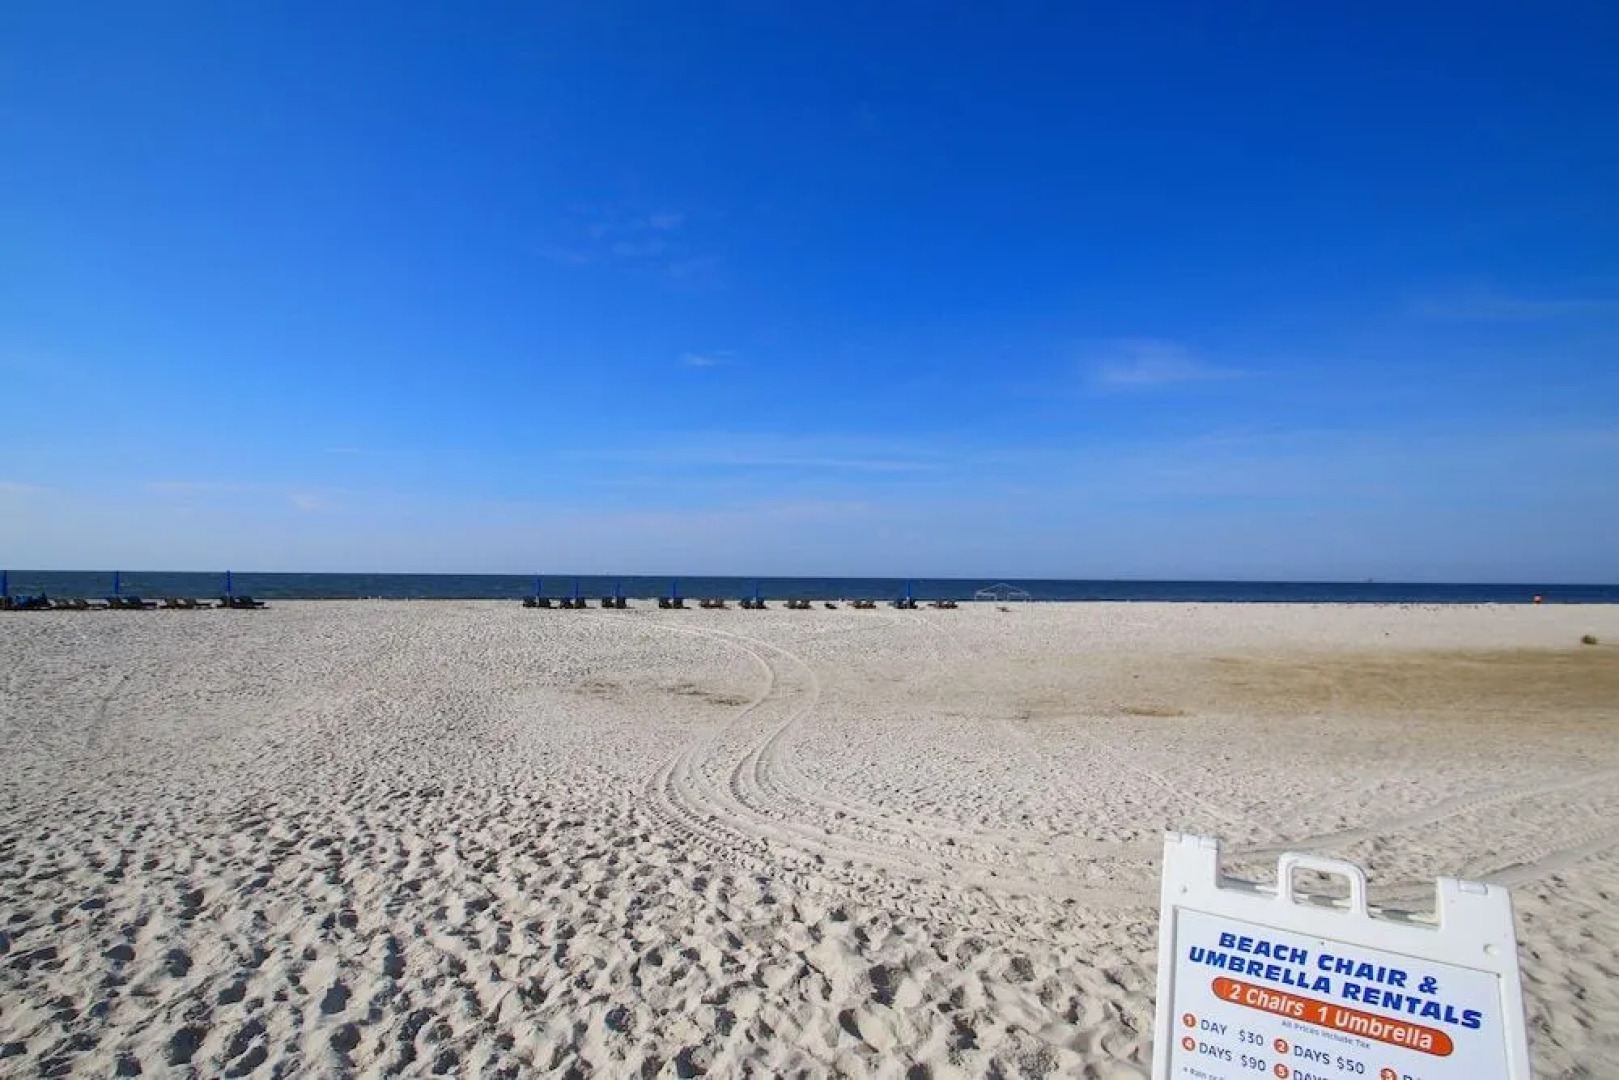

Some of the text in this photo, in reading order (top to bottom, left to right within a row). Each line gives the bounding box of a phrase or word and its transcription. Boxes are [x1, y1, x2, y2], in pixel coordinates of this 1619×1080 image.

[1219, 932, 1438, 994] BEACH CHAIR &
[1189, 947, 1482, 1029] UMBRELLA RENTALS
[1230, 984, 1432, 1049] 2 Chairs 1 Umbrella
[1201, 1019, 1227, 1035] DAY
[1239, 1030, 1264, 1046] $30
[1200, 1042, 1232, 1061] DAYS
[1241, 1055, 1266, 1071] $90
[1294, 1045, 1330, 1065] DAYS
[1337, 1056, 1364, 1074] $50
[1294, 1070, 1329, 1080] DAY
